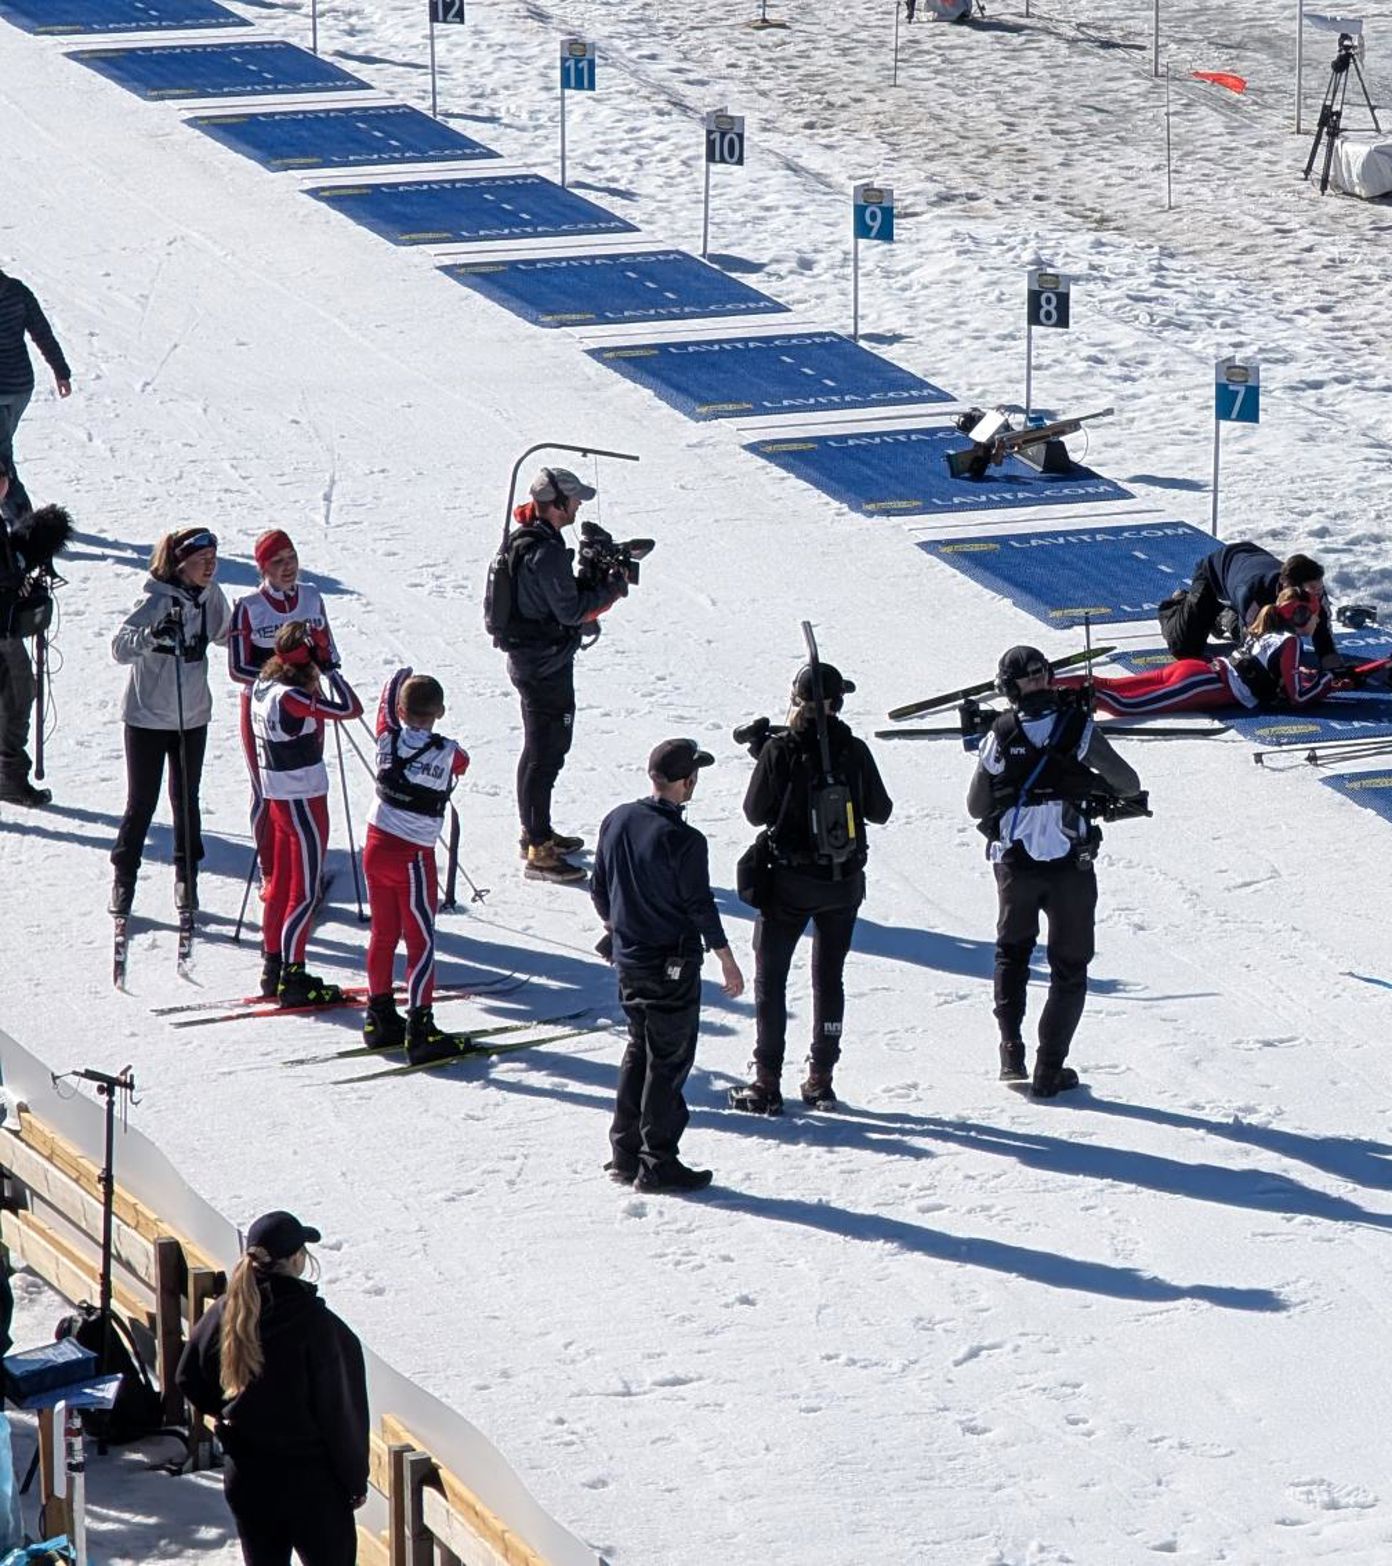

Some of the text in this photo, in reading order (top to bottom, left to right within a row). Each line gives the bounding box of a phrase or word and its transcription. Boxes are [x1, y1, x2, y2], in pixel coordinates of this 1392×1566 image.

[565, 59, 588, 89] 11
[709, 132, 740, 163] 10
[380, 177, 541, 193] LAVITA.COM
[459, 220, 625, 237] LAVITA.COM
[865, 206, 882, 238] 9
[516, 253, 682, 270] LAVITA.COM
[603, 301, 775, 318] LAVITA.COM
[1039, 292, 1058, 325] 8
[668, 336, 839, 354] LAVITA.COM
[762, 388, 938, 407] LAVITA.COM
[1228, 385, 1246, 419] 7
[931, 485, 1115, 505] LAVITA.COM
[1008, 527, 1195, 548] LAVITA.COM
